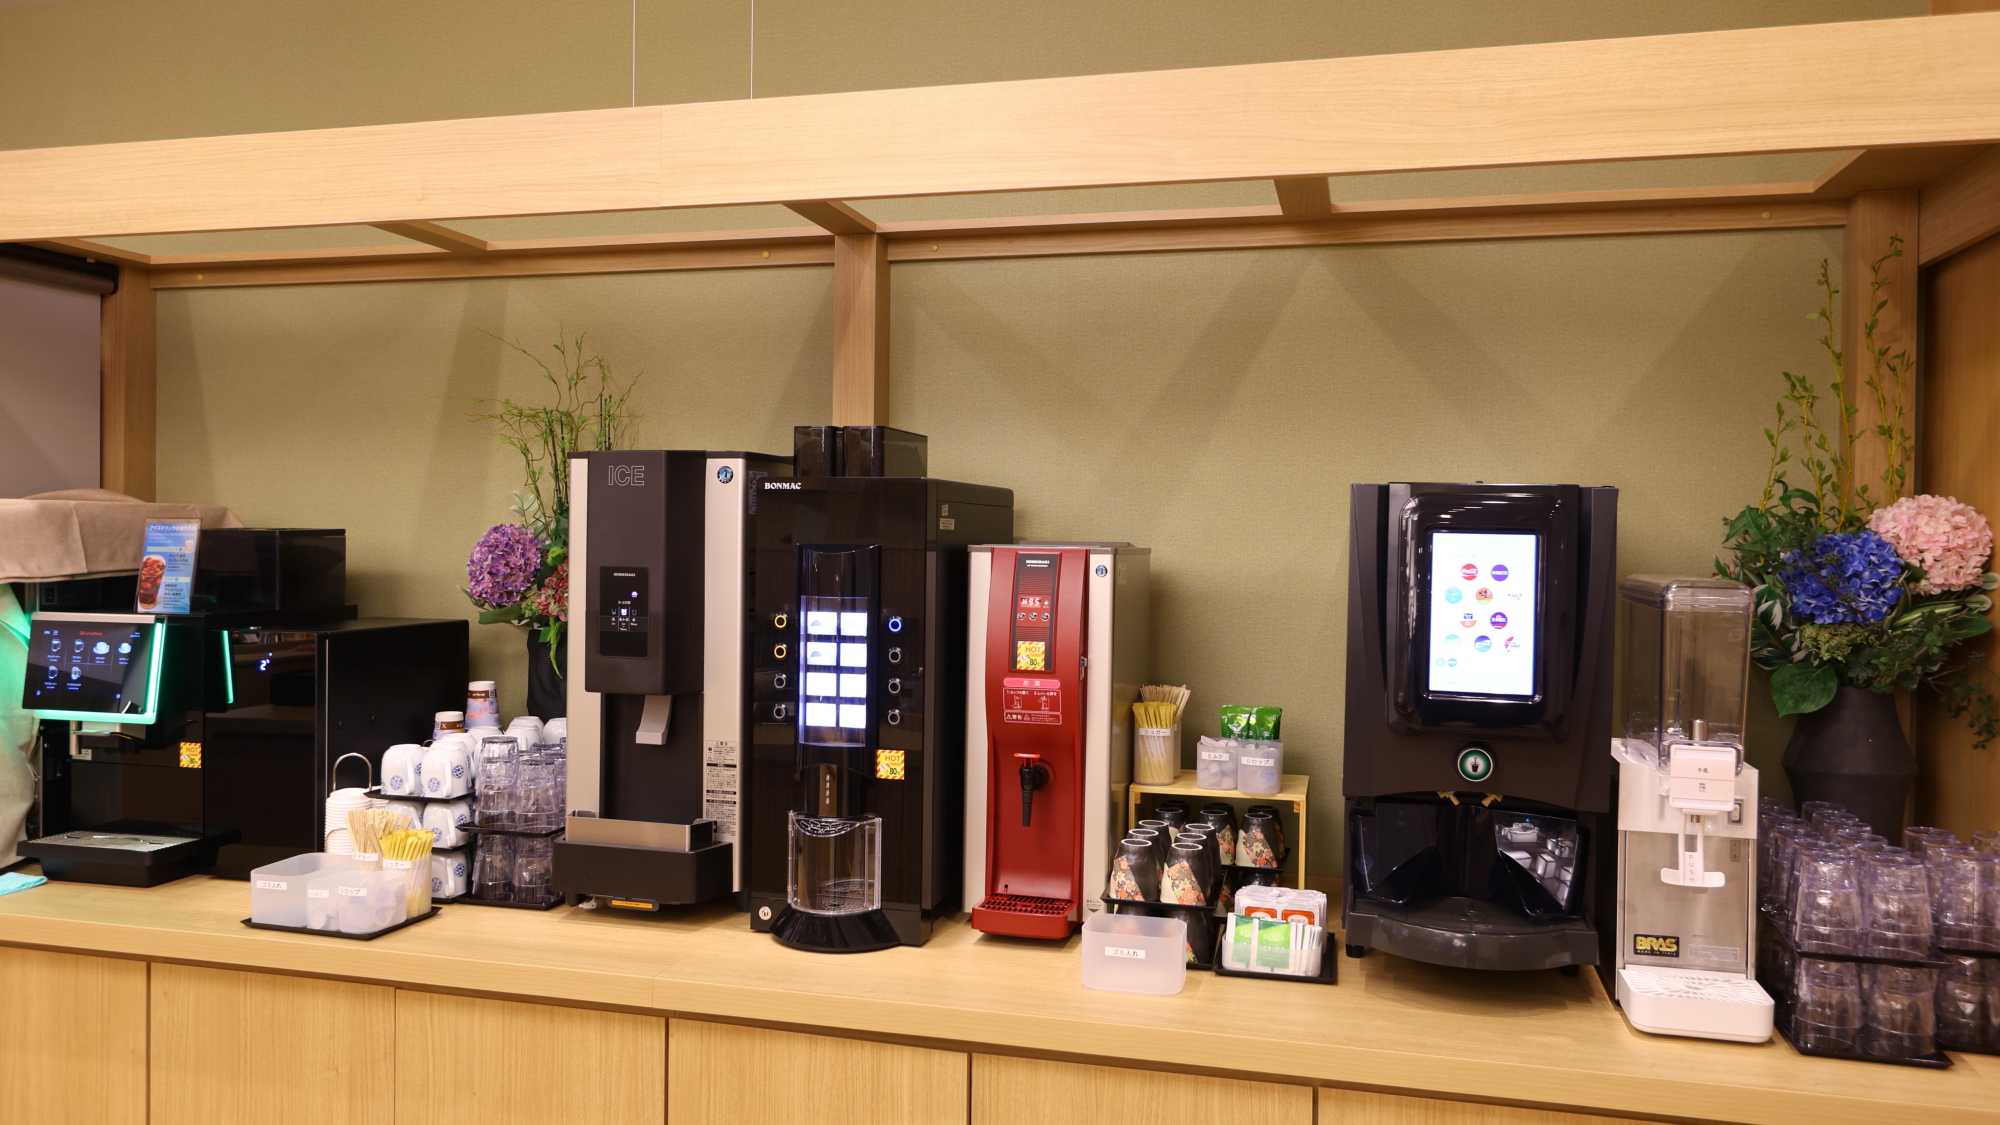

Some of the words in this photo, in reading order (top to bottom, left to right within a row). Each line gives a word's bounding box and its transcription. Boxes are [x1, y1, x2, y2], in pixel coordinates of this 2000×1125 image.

[608, 465, 645, 486] ICE
[764, 482, 802, 490] BONMAC
[1246, 758, 1270, 766] シロップ
[339, 887, 361, 896] シロップ
[1635, 936, 1678, 952] BRAS
[1112, 948, 1139, 957] ゴミ入れ
